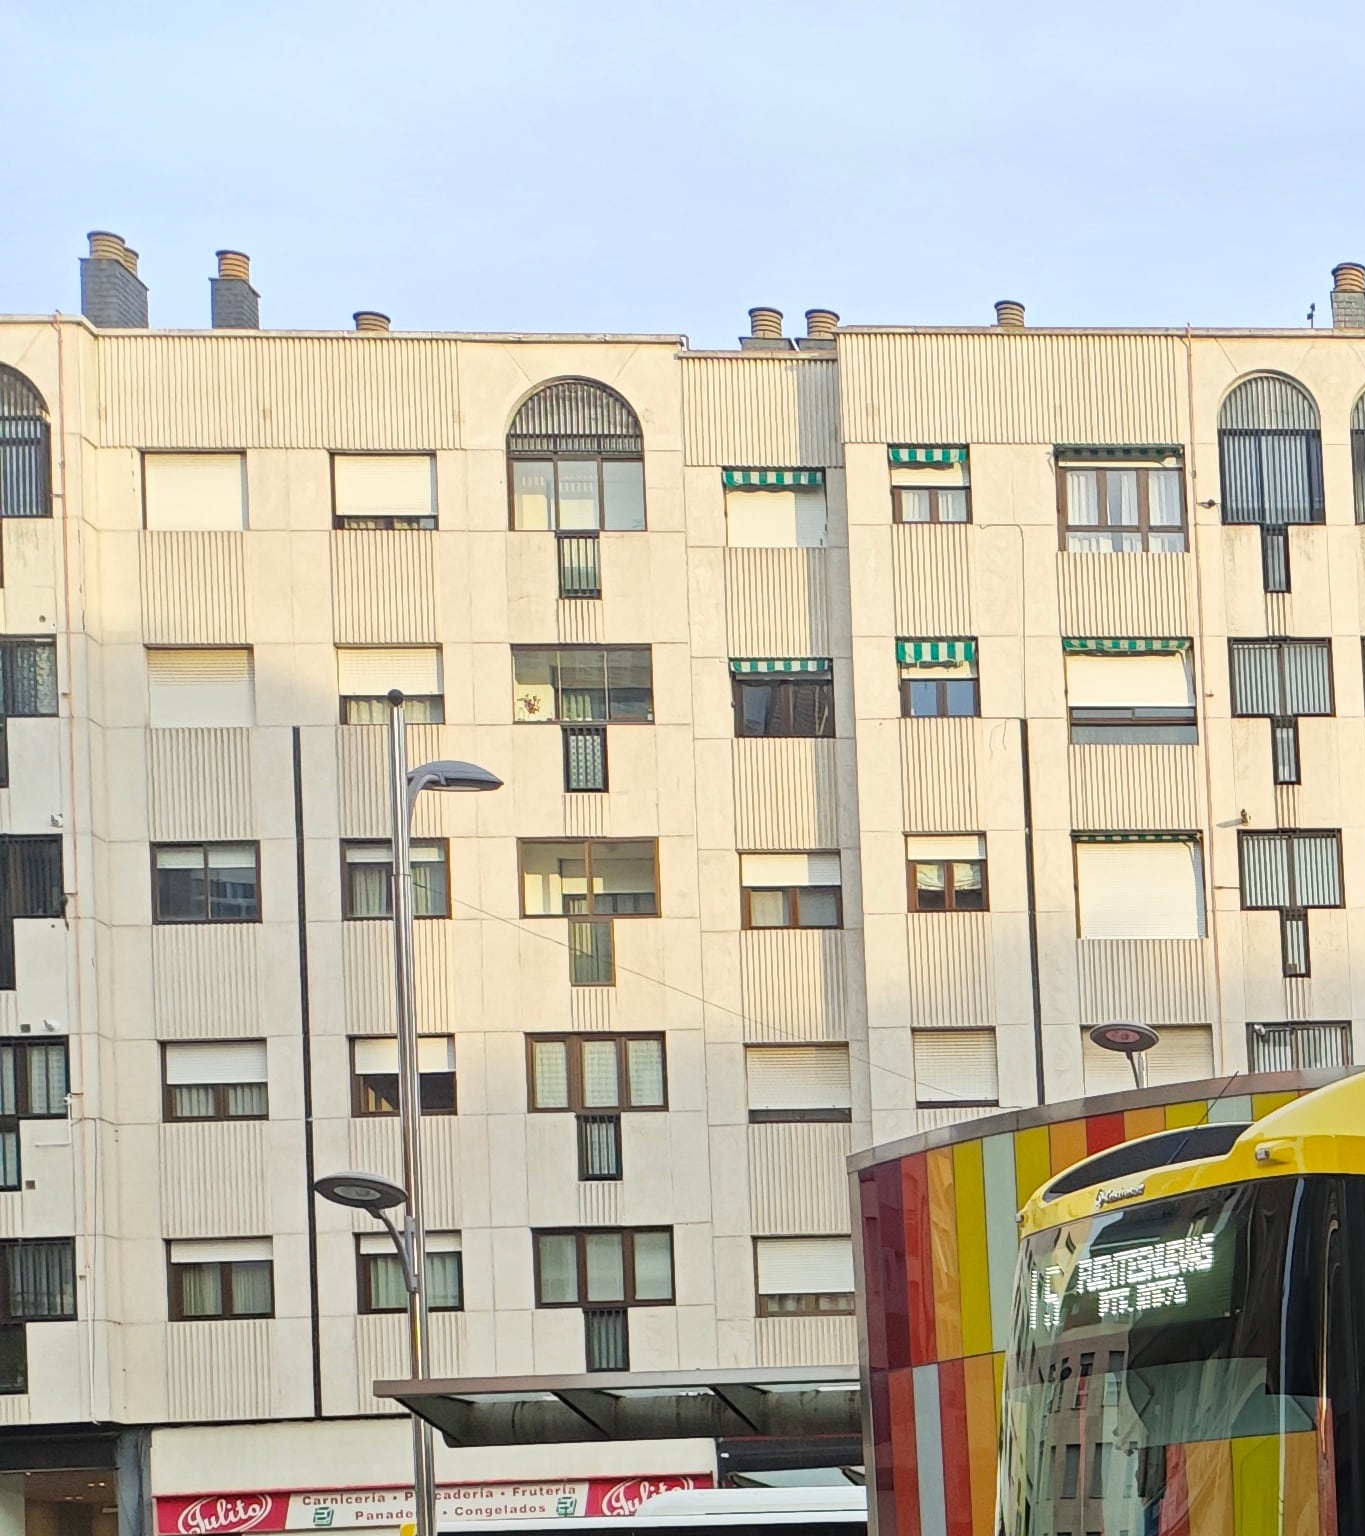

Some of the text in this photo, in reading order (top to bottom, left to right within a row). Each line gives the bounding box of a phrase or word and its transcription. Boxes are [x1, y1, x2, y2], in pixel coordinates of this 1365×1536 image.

[302, 1484, 577, 1506] Carnicería Pcadería Frutería
[611, 1481, 682, 1515] Julit
[186, 1500, 261, 1534] Julito
[355, 1504, 546, 1521] Panade Congelados
